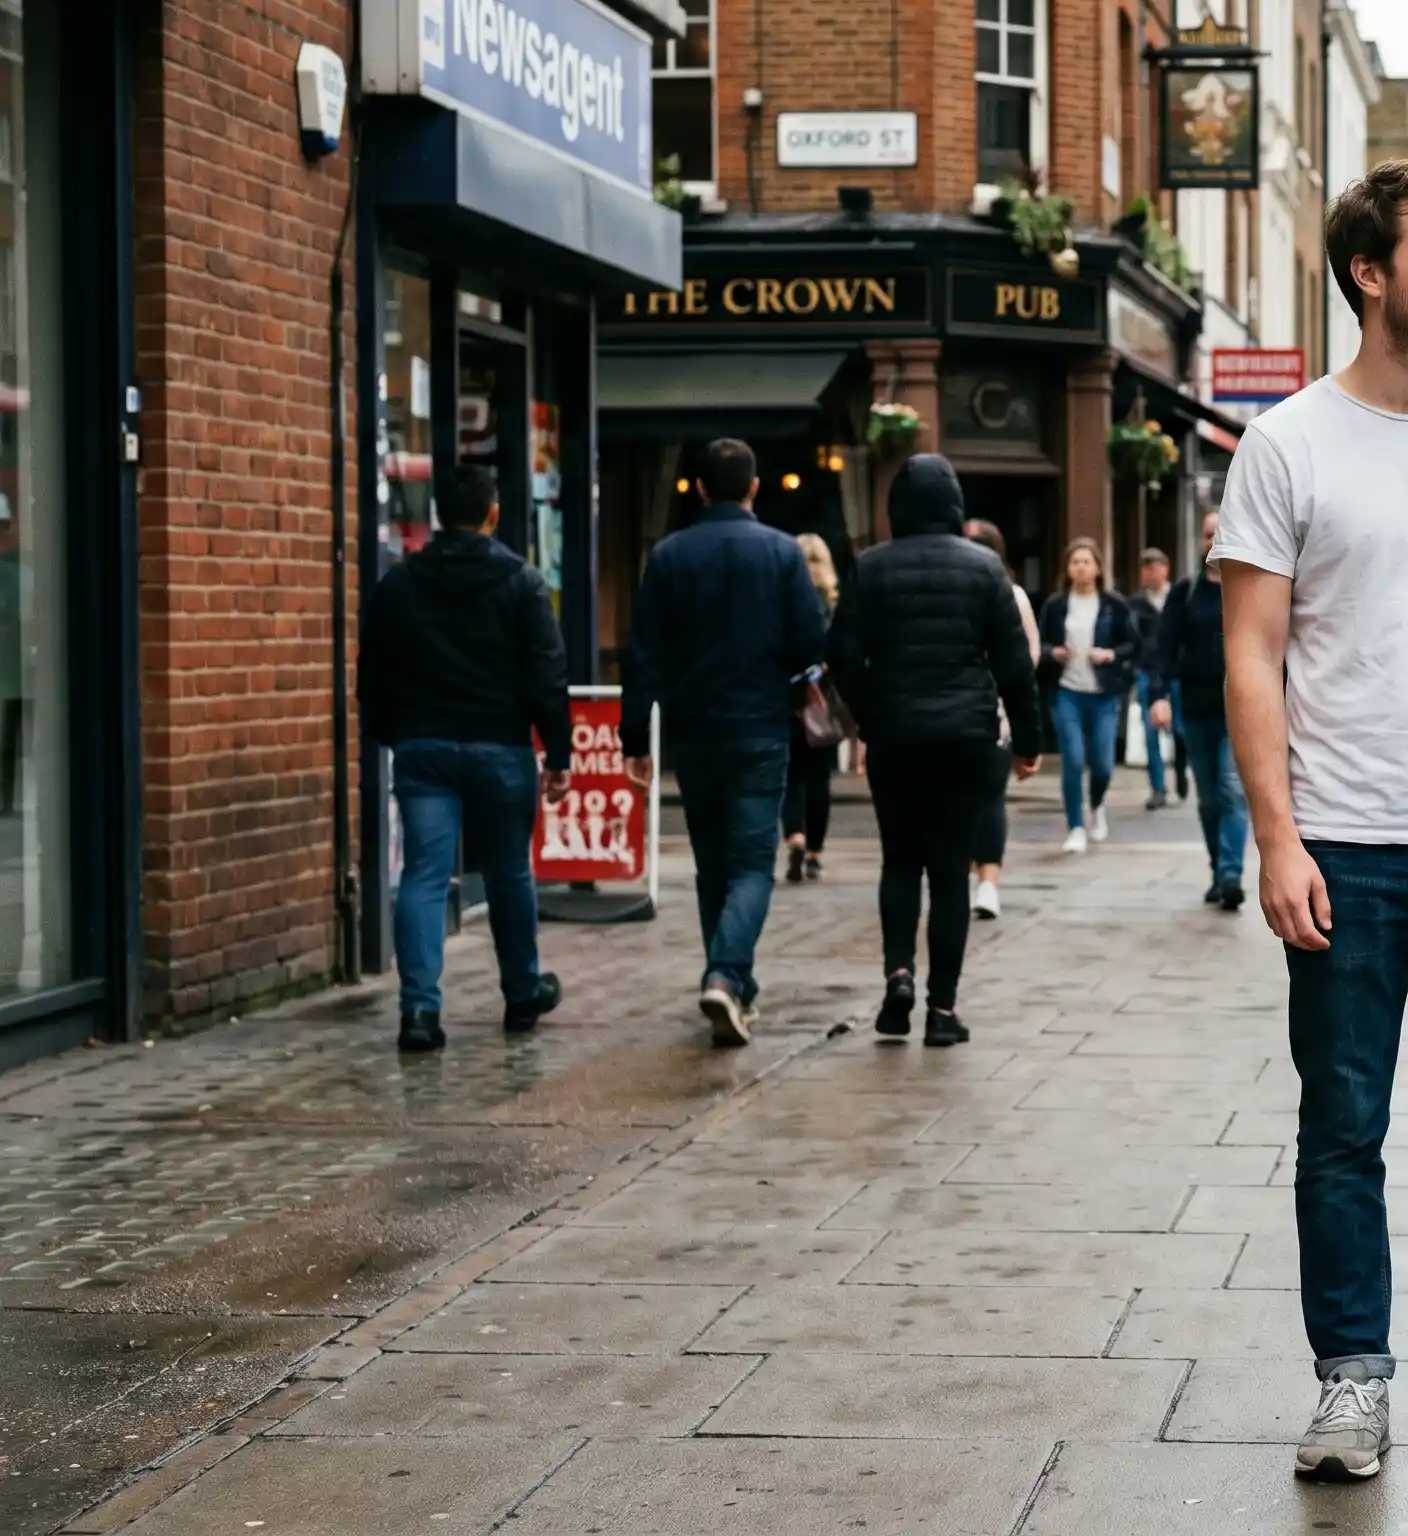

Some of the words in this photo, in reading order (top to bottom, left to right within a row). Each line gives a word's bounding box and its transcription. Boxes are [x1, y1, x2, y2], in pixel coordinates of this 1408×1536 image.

[453, 0, 624, 143] Newsagent
[722, 278, 896, 315] CROWN
[995, 283, 1061, 320] PUB
